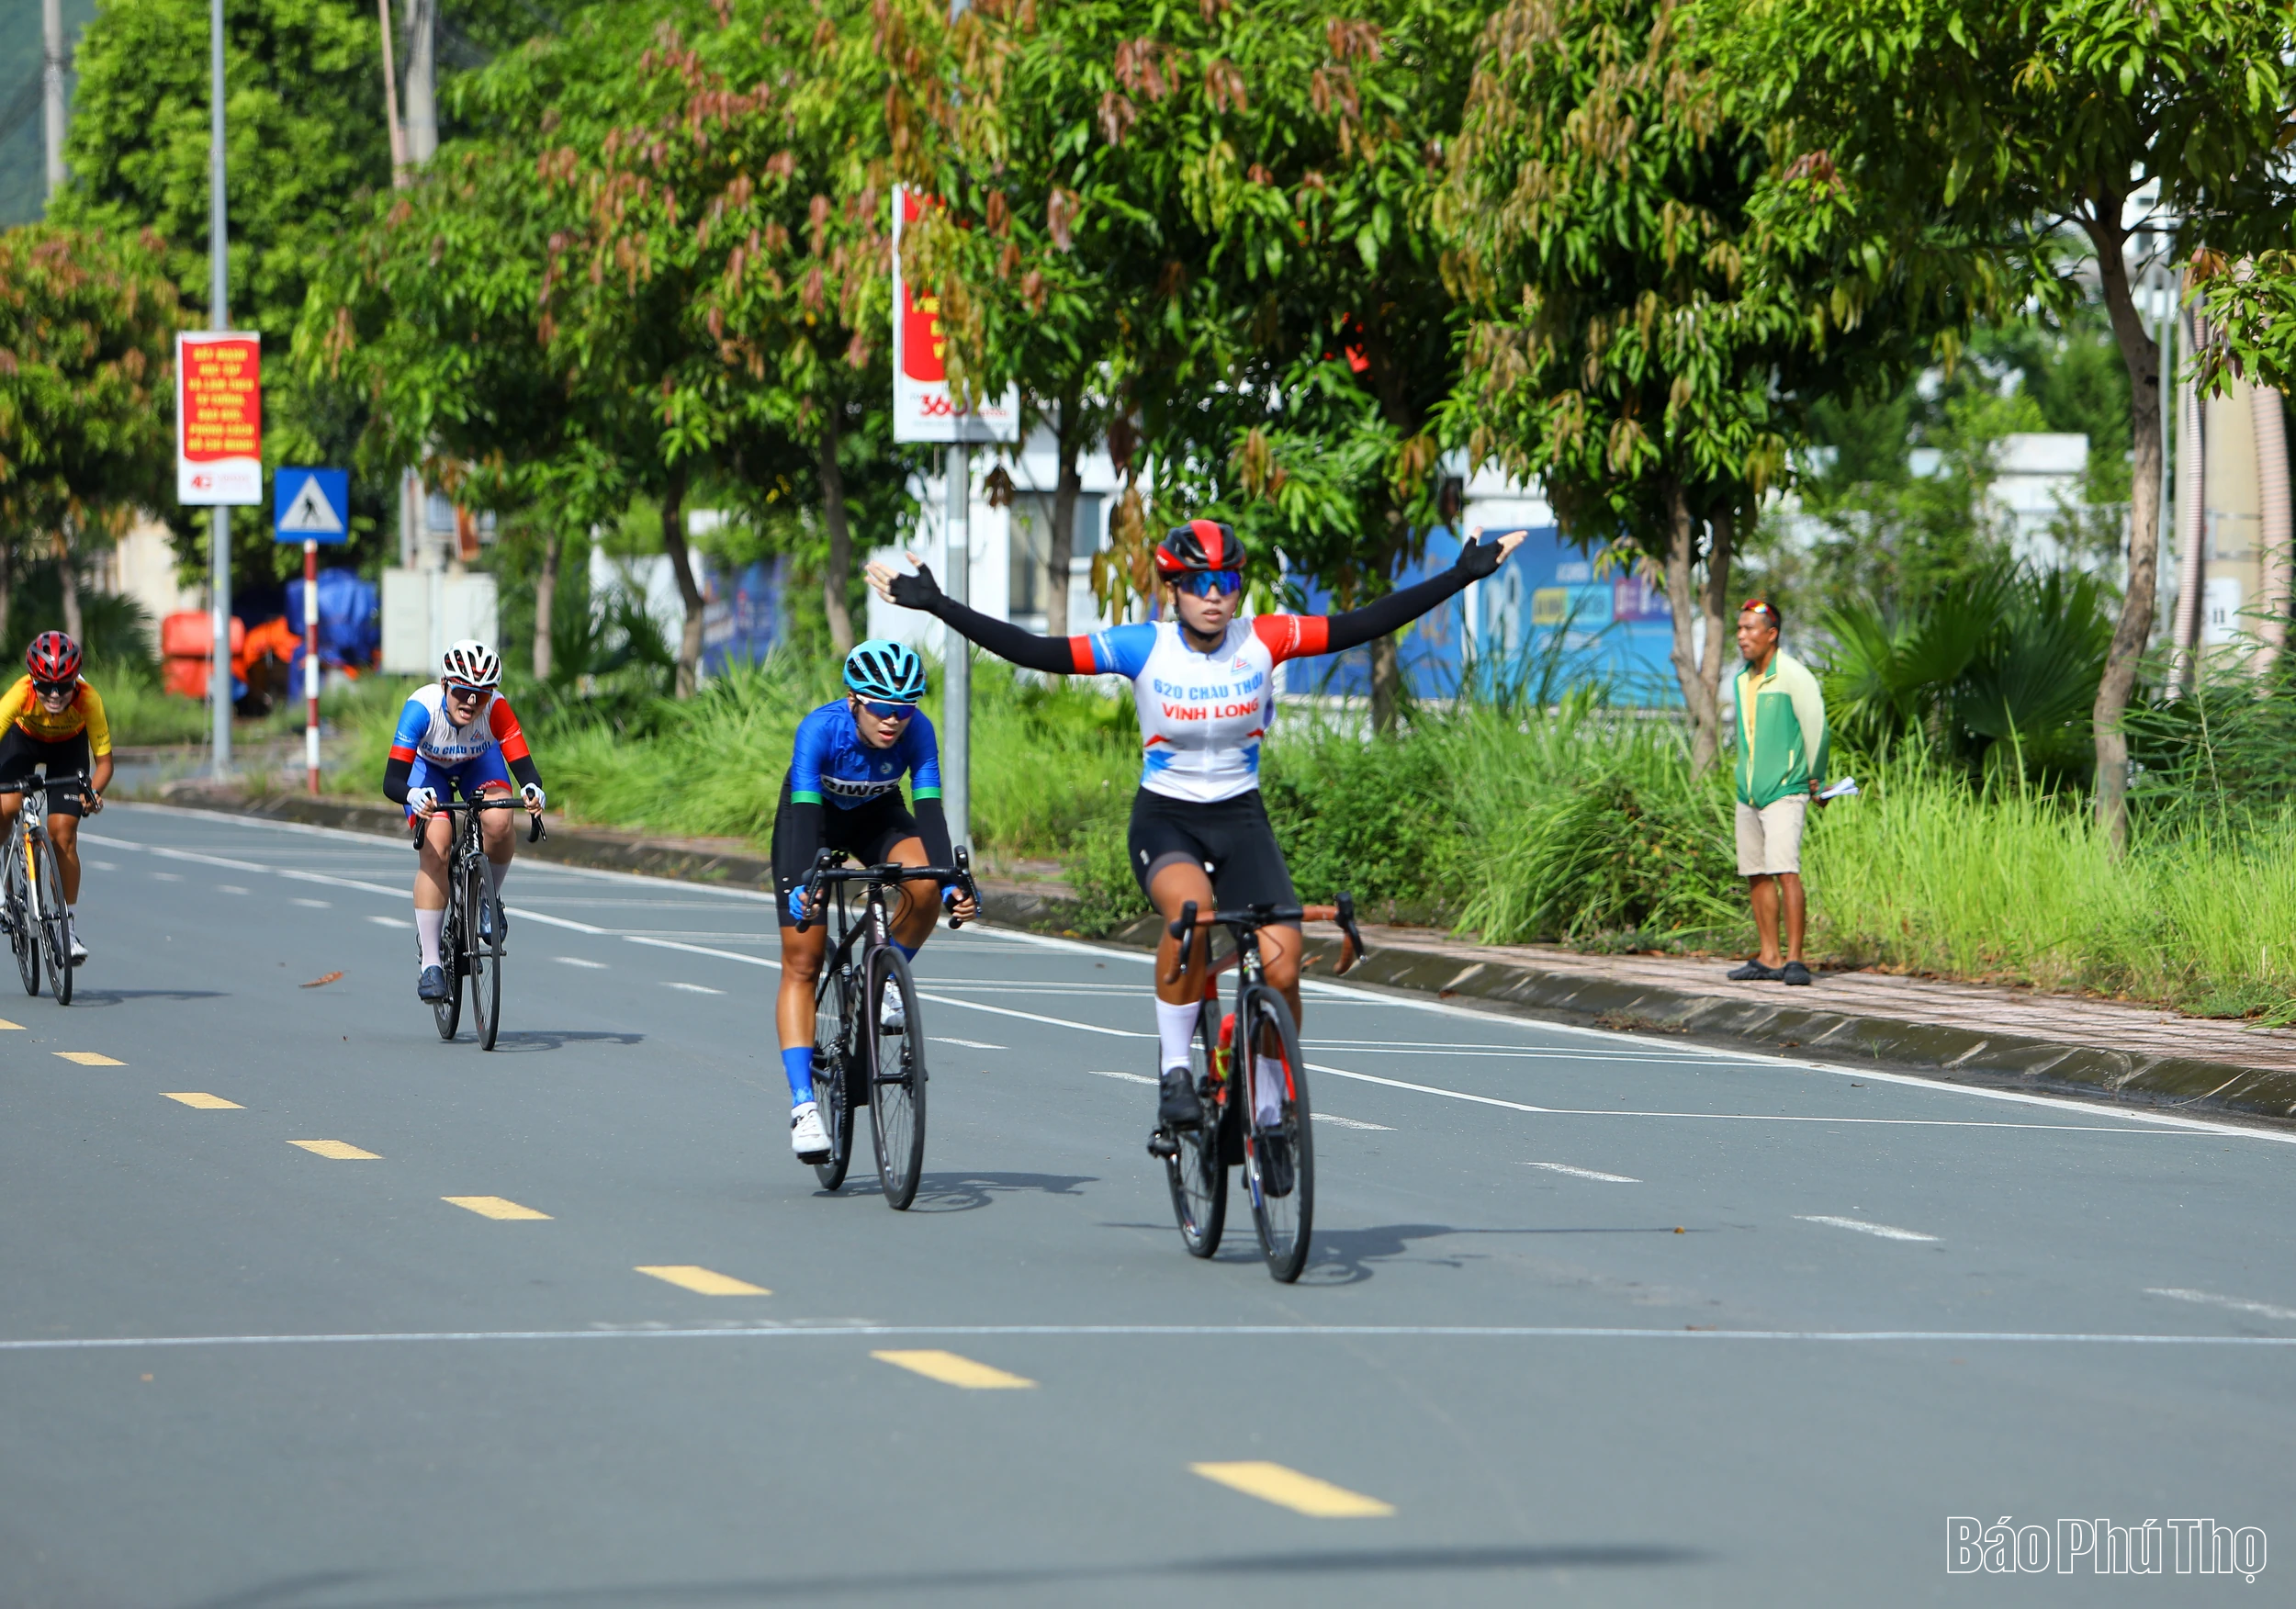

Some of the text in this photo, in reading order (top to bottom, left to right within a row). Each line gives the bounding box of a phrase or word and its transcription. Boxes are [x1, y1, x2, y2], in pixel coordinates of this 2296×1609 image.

[1154, 678, 1183, 699] 620
[1162, 697, 1259, 720] VĨNH LONG
[422, 741, 439, 754] 620
